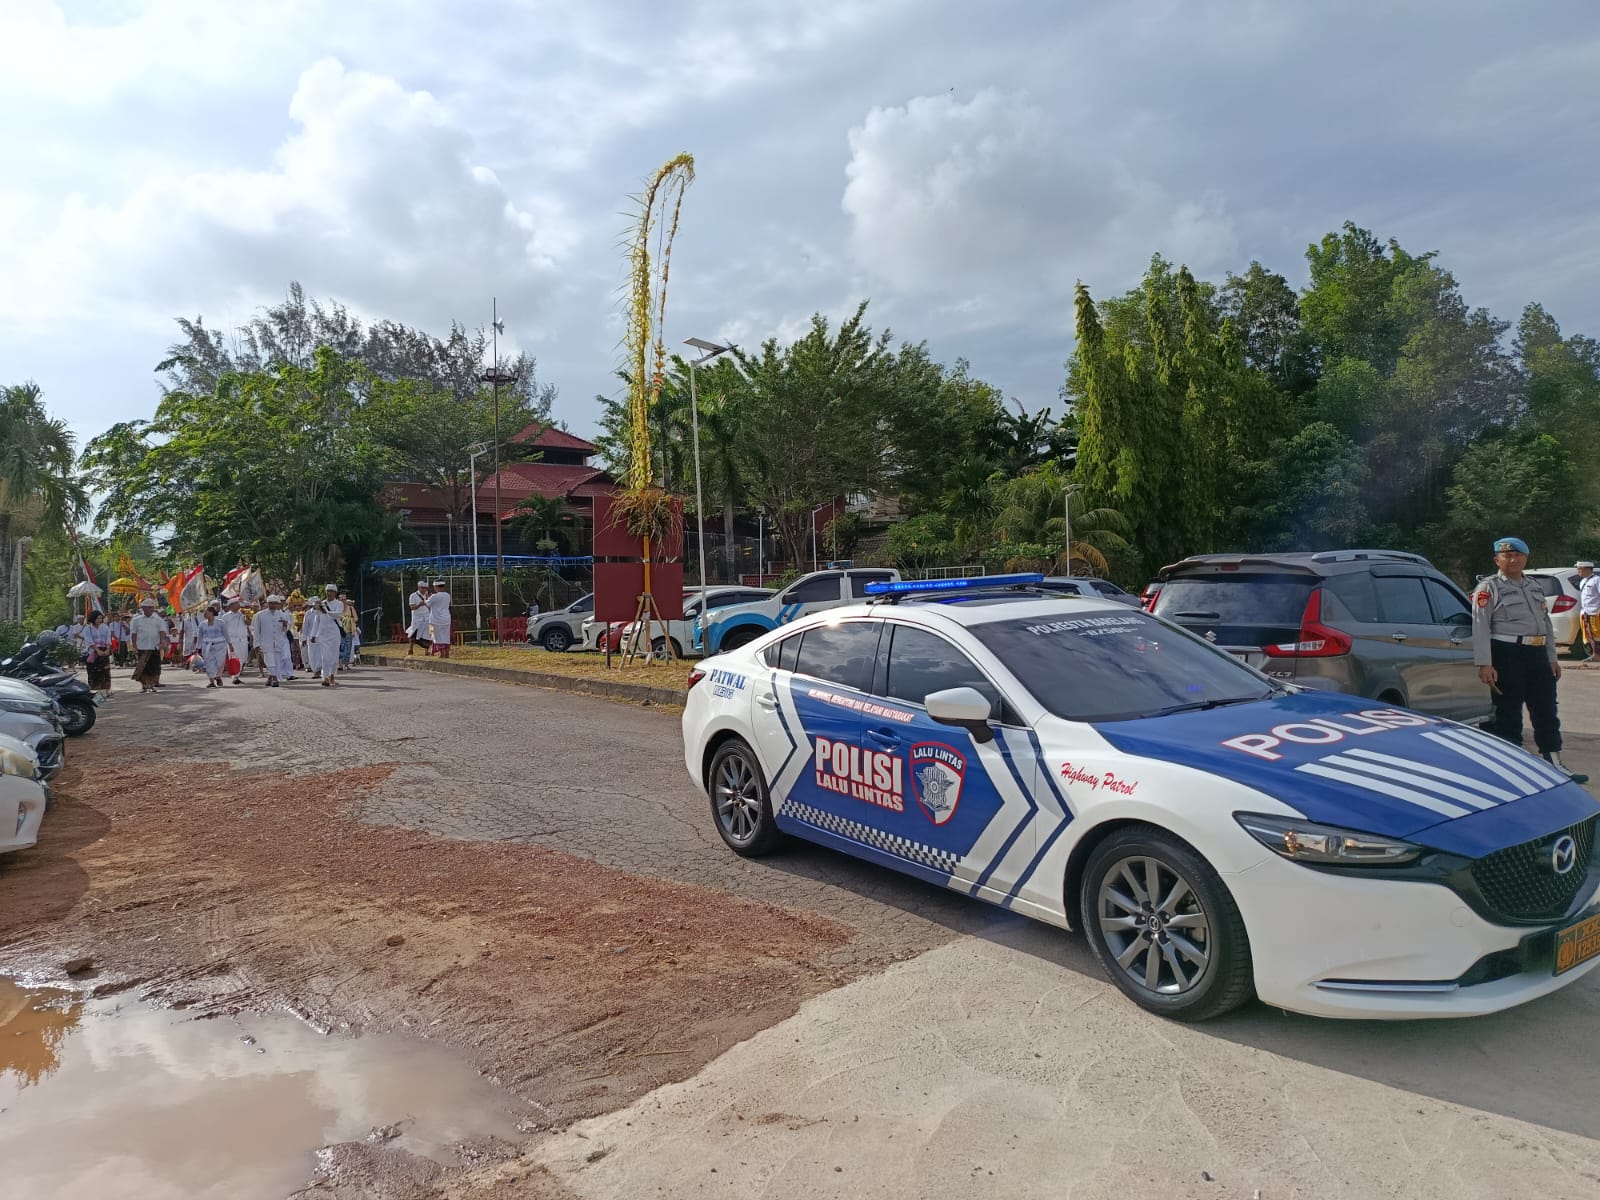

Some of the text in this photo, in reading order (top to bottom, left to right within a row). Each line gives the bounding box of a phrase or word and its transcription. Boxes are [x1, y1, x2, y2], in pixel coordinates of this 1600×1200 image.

[1026, 619, 1093, 636] POLRESTA
[709, 668, 746, 690] PATWAL
[1221, 708, 1441, 760] POLISI
[815, 736, 904, 795] POLISI
[913, 747, 963, 770] LALU LINTAS
[815, 771, 904, 813] LALU LINTAS
[1060, 762, 1139, 796] Highway Patrol
